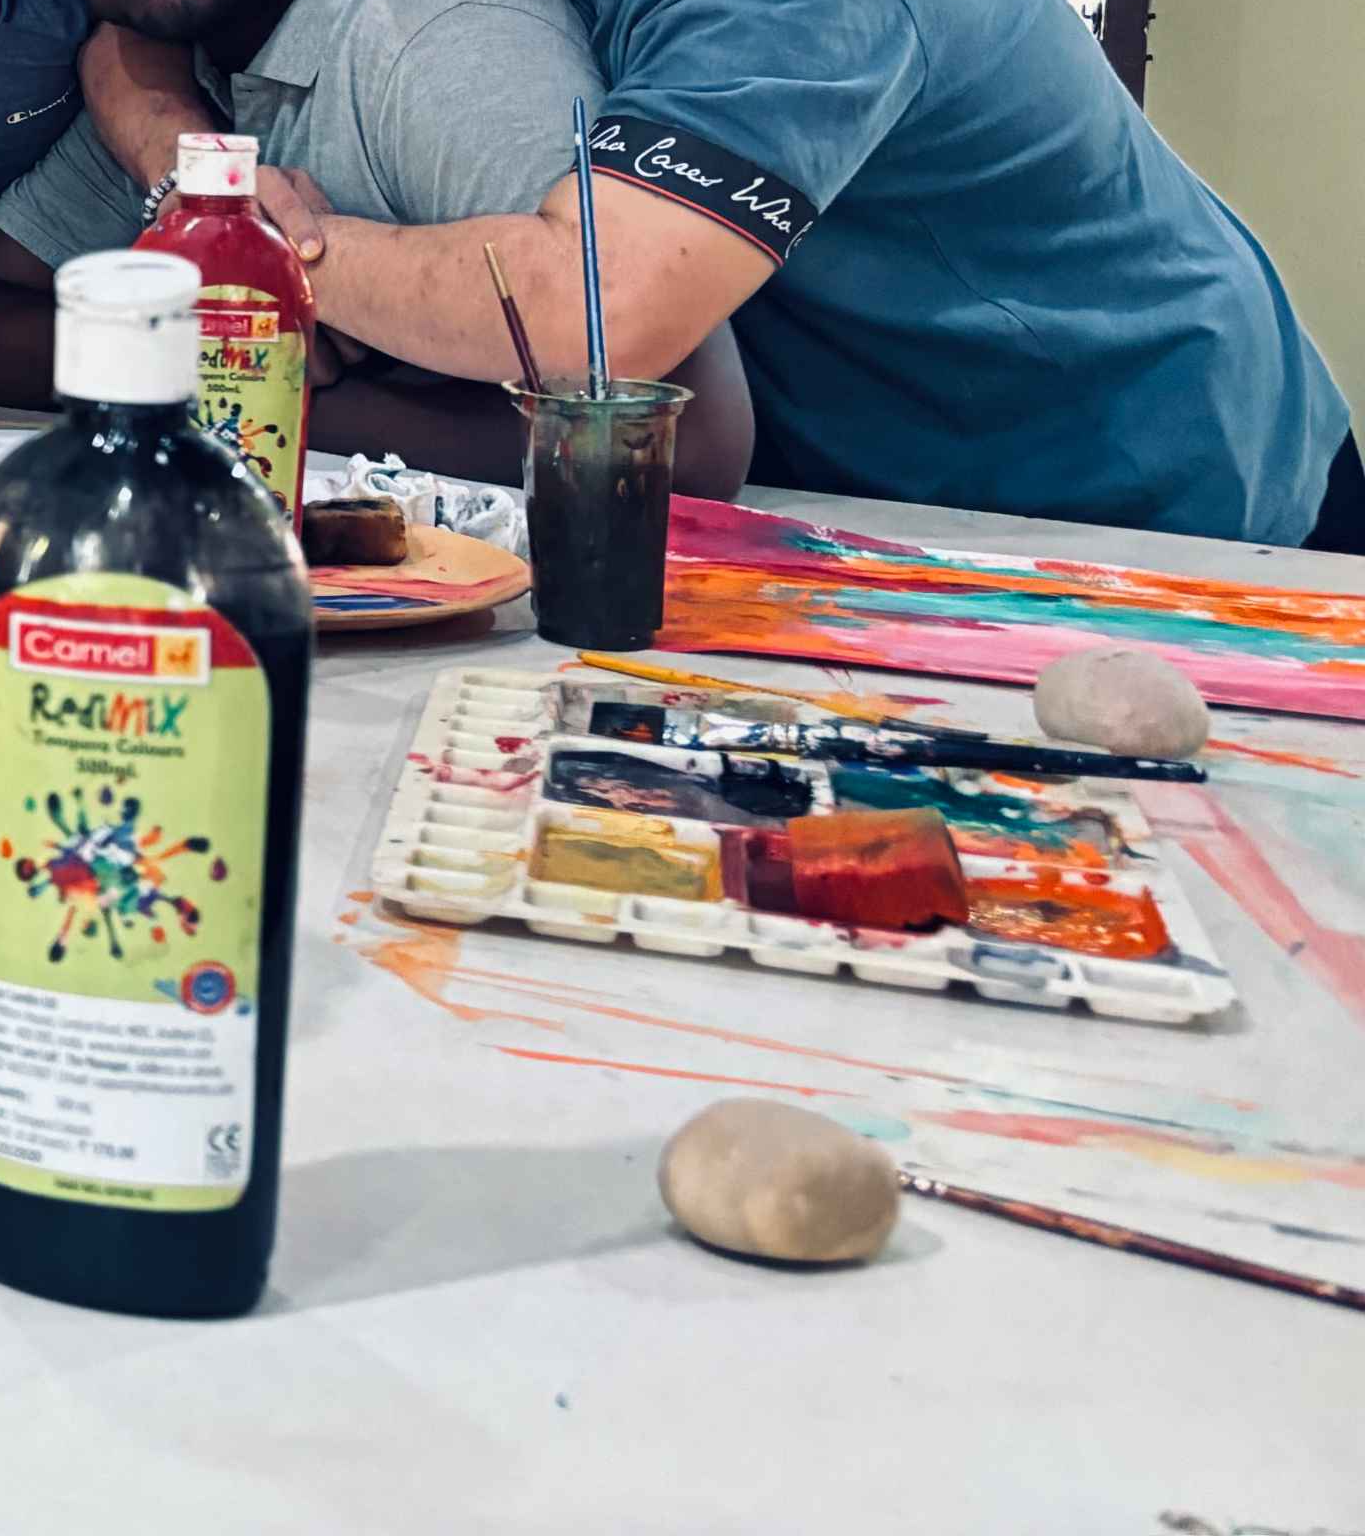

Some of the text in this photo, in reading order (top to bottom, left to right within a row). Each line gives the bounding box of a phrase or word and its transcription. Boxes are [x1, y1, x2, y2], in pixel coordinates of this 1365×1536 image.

[589, 123, 627, 152] ho
[634, 137, 724, 188] Cares
[24, 629, 150, 667] Camel
